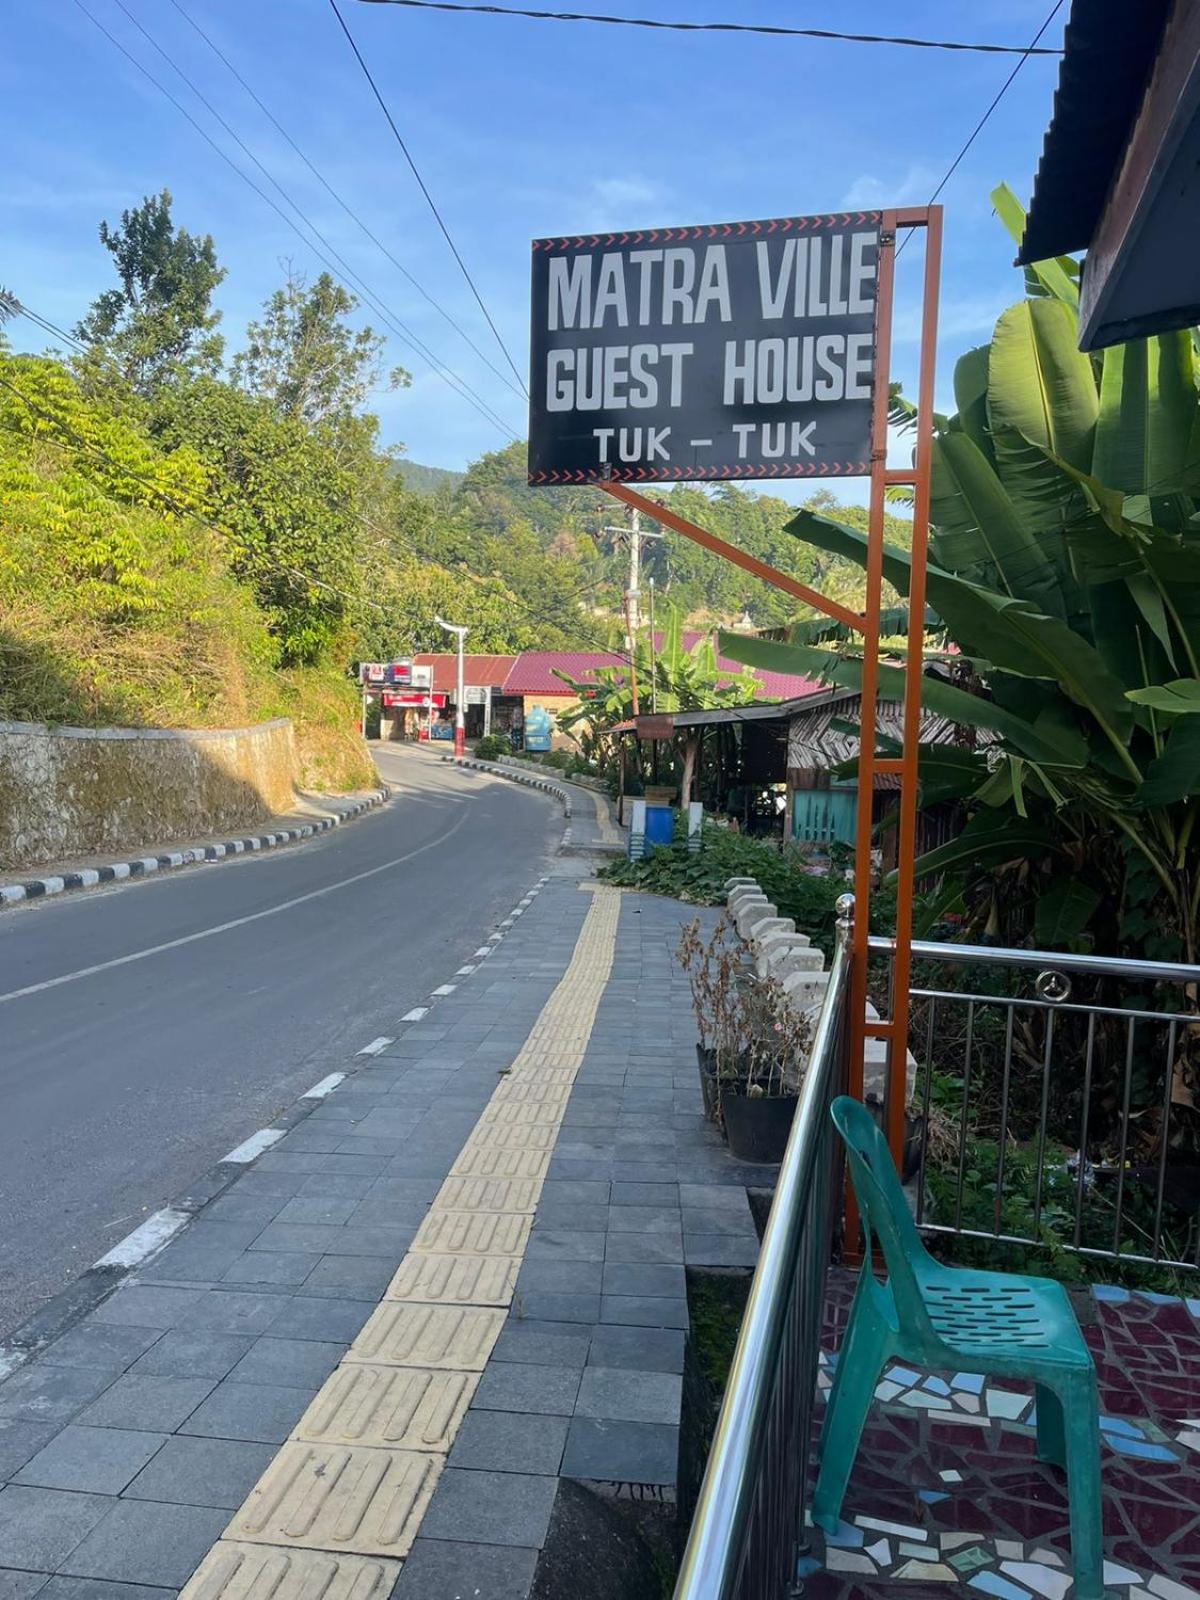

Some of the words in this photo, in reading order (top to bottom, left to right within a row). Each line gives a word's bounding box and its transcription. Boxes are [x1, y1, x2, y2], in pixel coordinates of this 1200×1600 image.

[547, 244, 732, 331] MATRA
[756, 231, 878, 320] VILLE
[546, 342, 694, 412] GUEST
[723, 333, 873, 406] HOUSE
[593, 427, 671, 462] TUK
[732, 421, 817, 458] TUK
